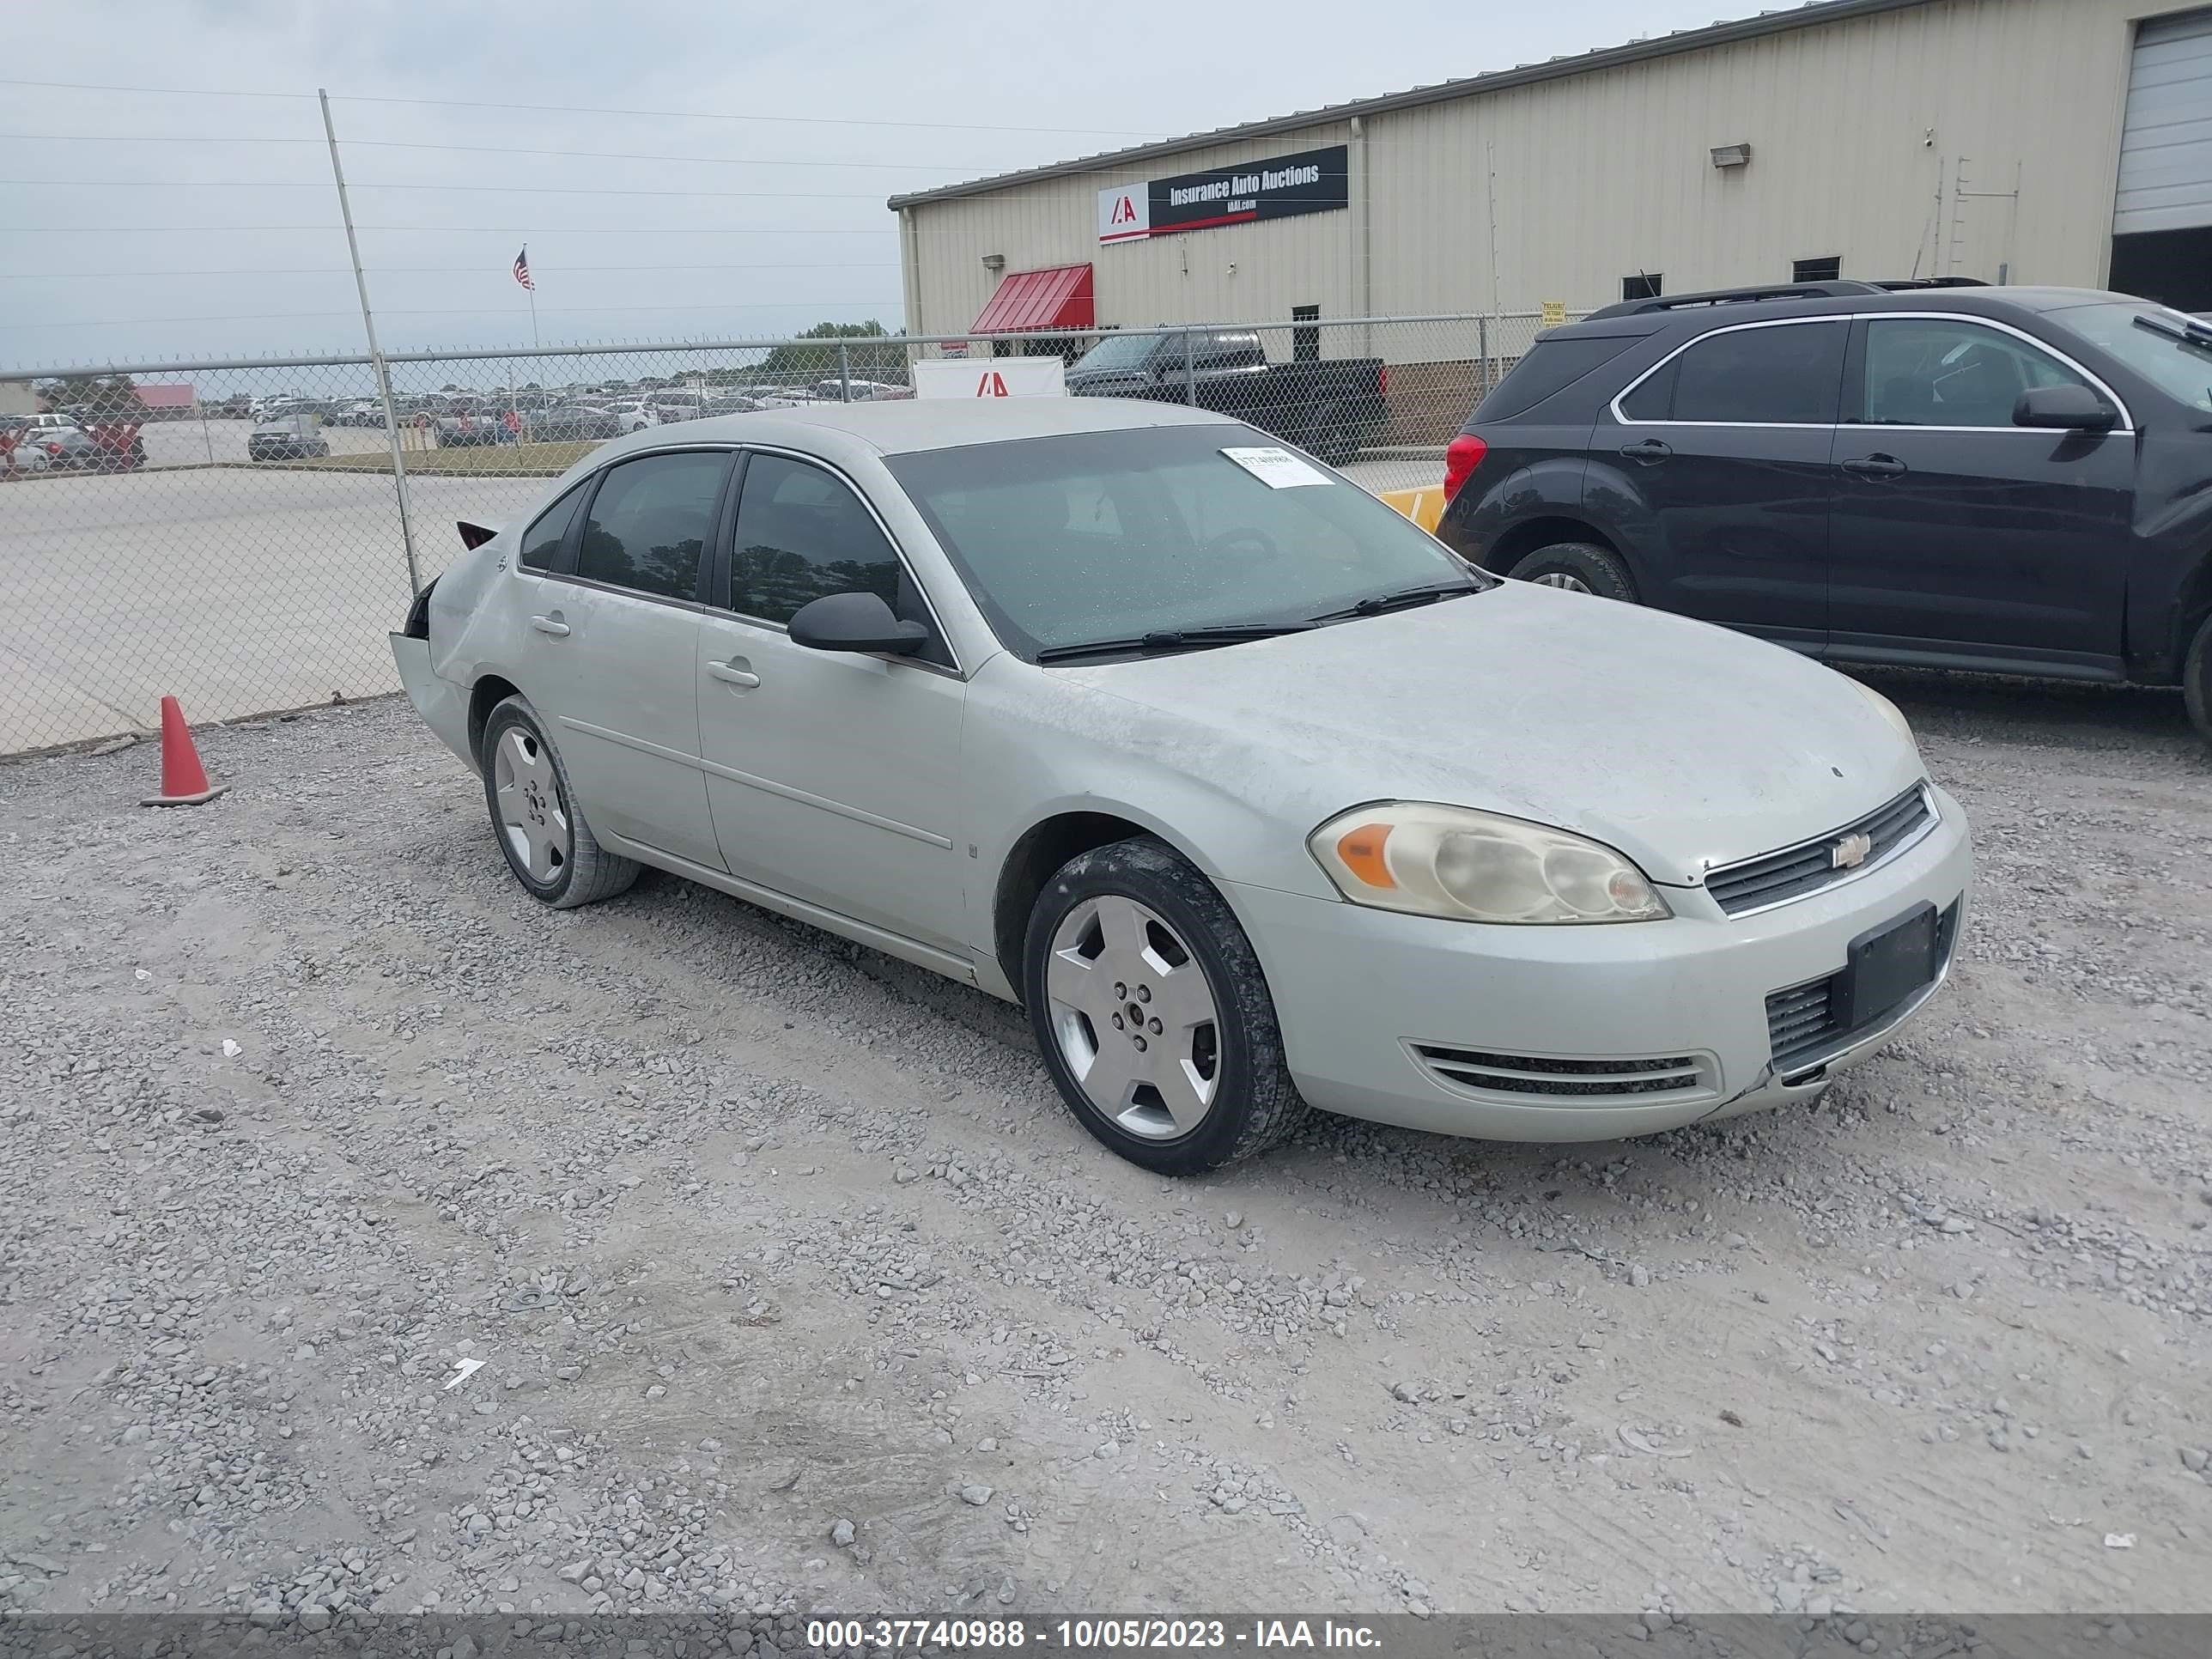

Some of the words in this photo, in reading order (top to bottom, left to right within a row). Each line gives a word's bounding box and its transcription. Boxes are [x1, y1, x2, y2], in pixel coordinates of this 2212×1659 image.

[1170, 180, 1230, 206] Insurance
[1231, 174, 1260, 196] Auto
[1261, 164, 1319, 191] Auctions
